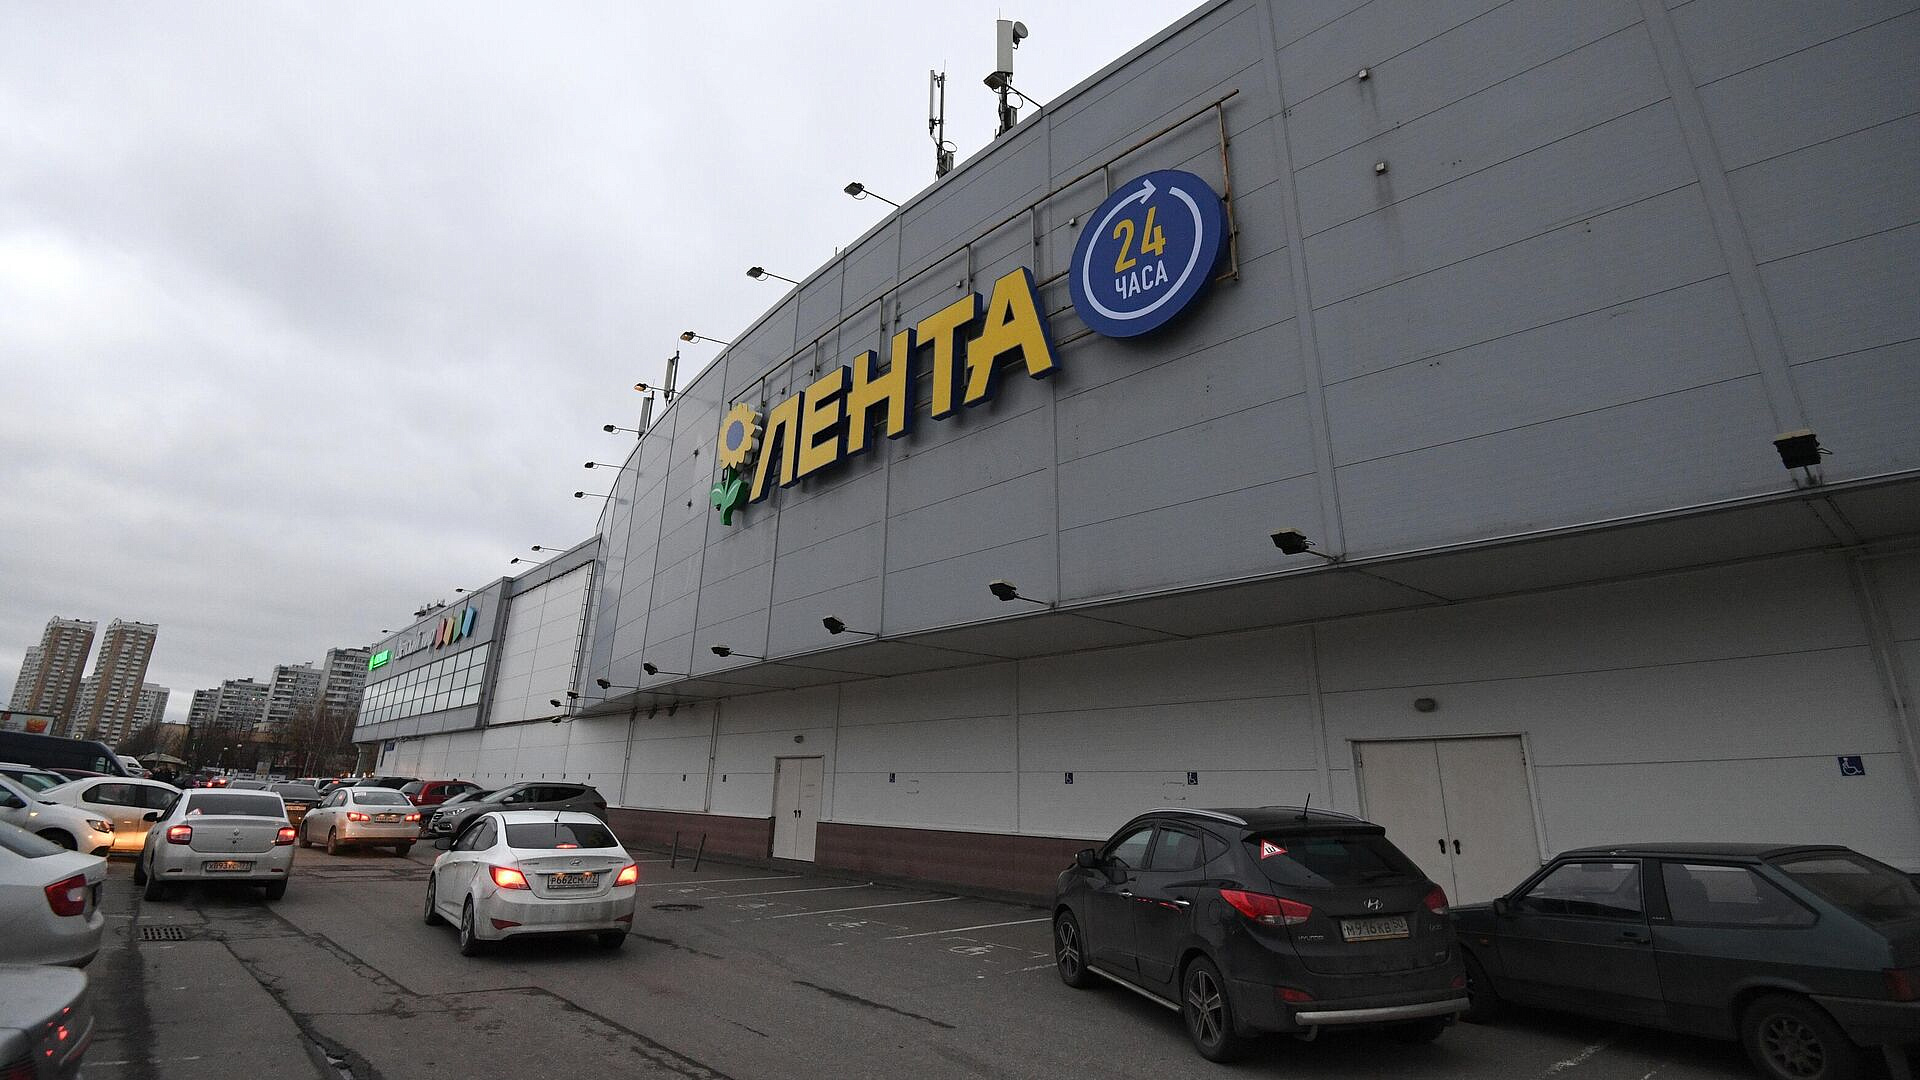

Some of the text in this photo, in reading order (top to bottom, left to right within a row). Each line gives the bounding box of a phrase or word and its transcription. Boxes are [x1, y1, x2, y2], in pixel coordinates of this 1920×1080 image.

[1113, 206, 1166, 273] 24
[1115, 260, 1168, 299] ЧАСА
[749, 266, 1056, 504] ЛЕНТА
